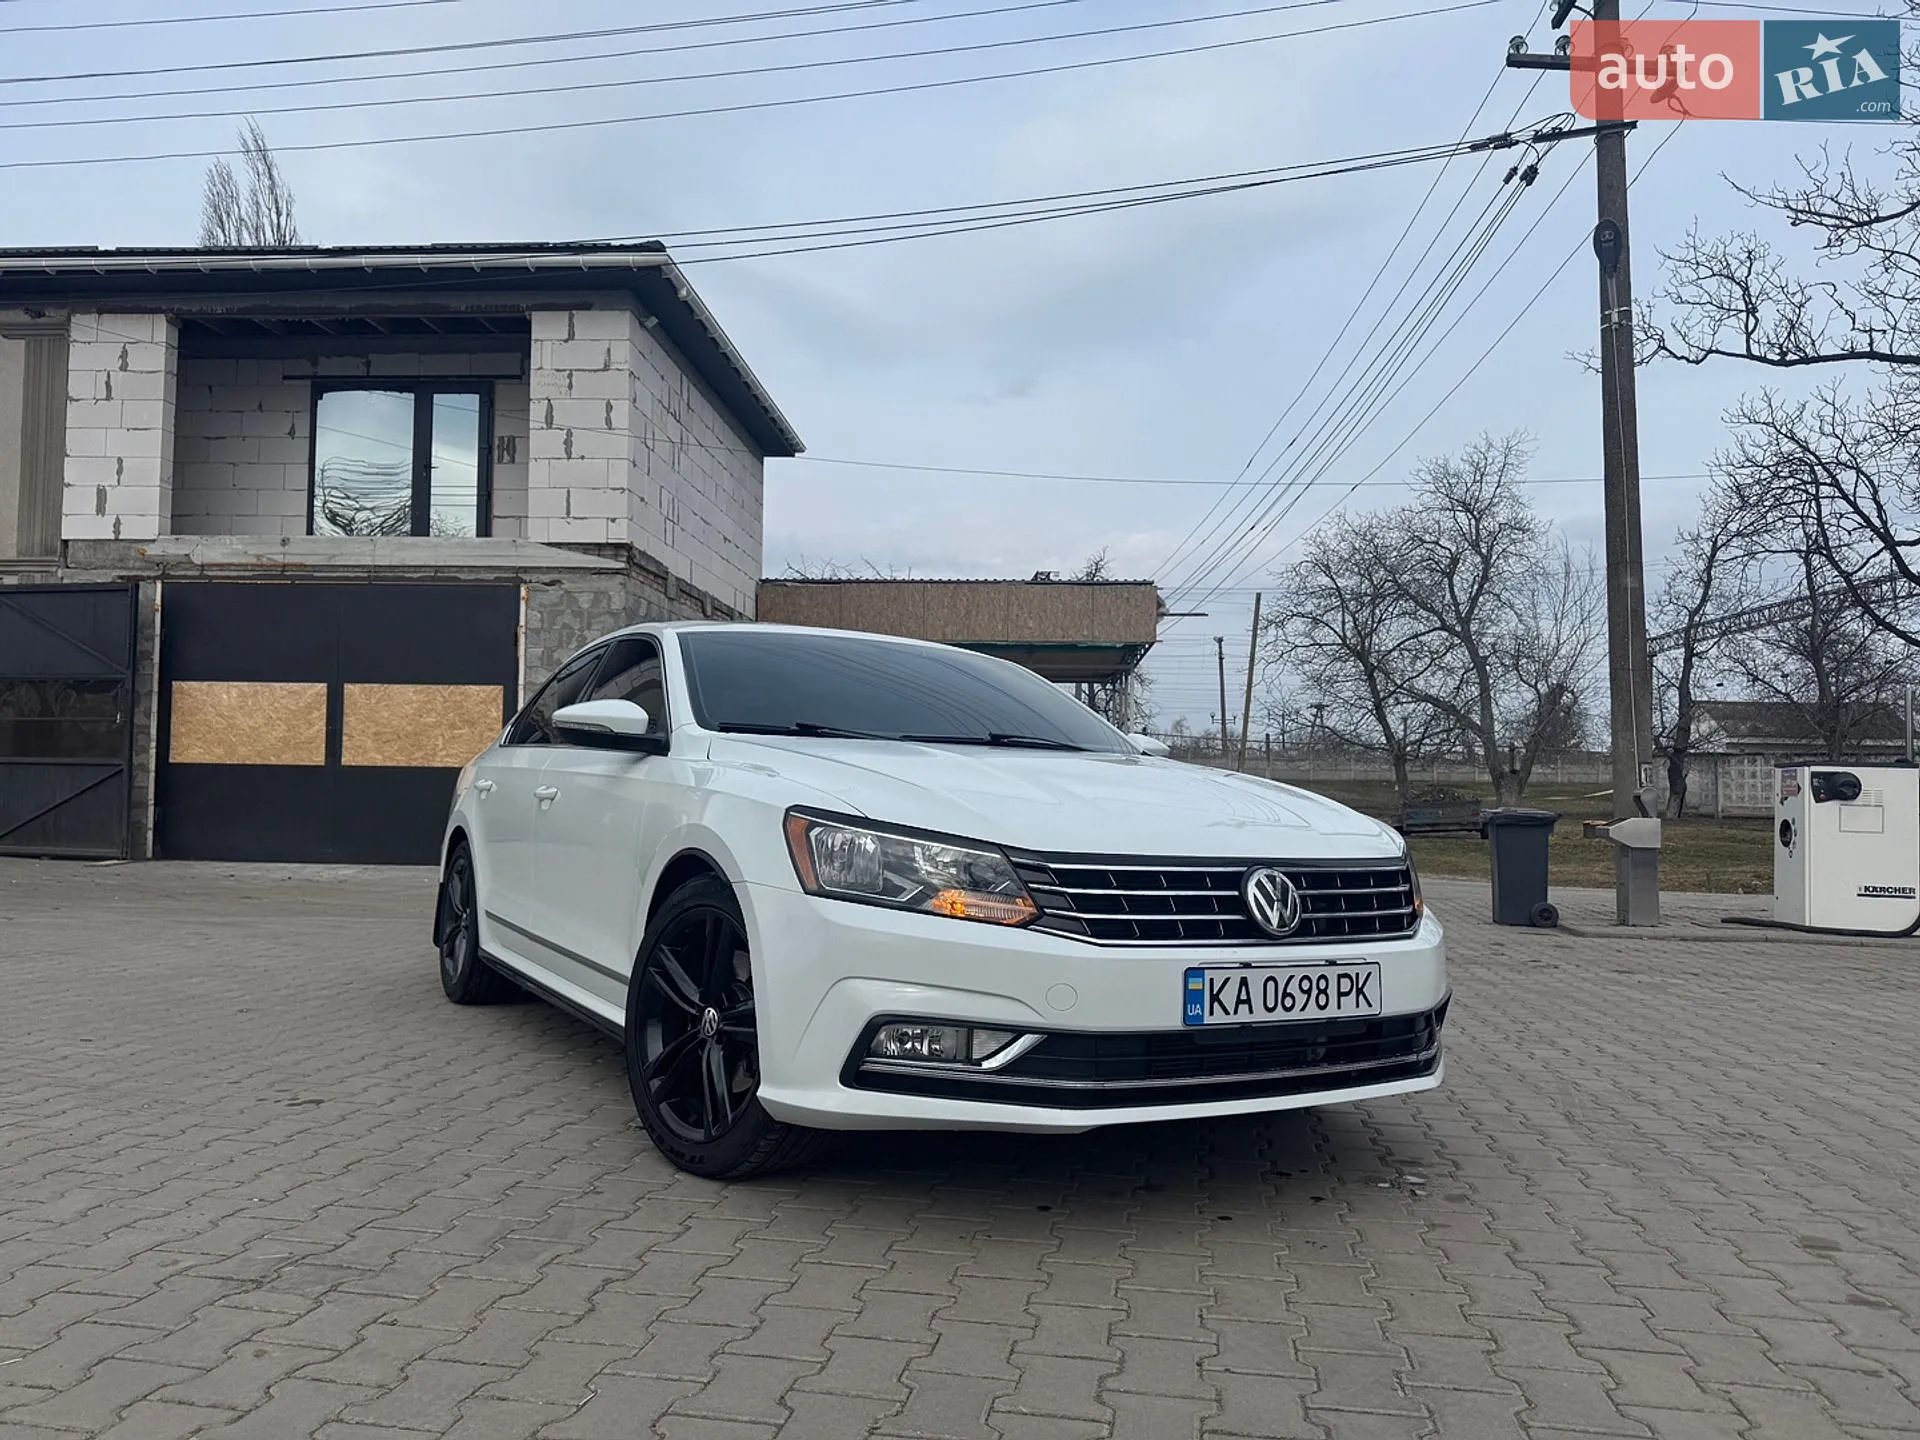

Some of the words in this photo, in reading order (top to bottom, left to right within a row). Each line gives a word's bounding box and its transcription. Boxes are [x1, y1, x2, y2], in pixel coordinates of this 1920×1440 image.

[1209, 976, 1254, 1016] KA
[1262, 974, 1330, 1013] 0698
[1337, 971, 1373, 1010] PK
[1187, 1003, 1202, 1016] UA
